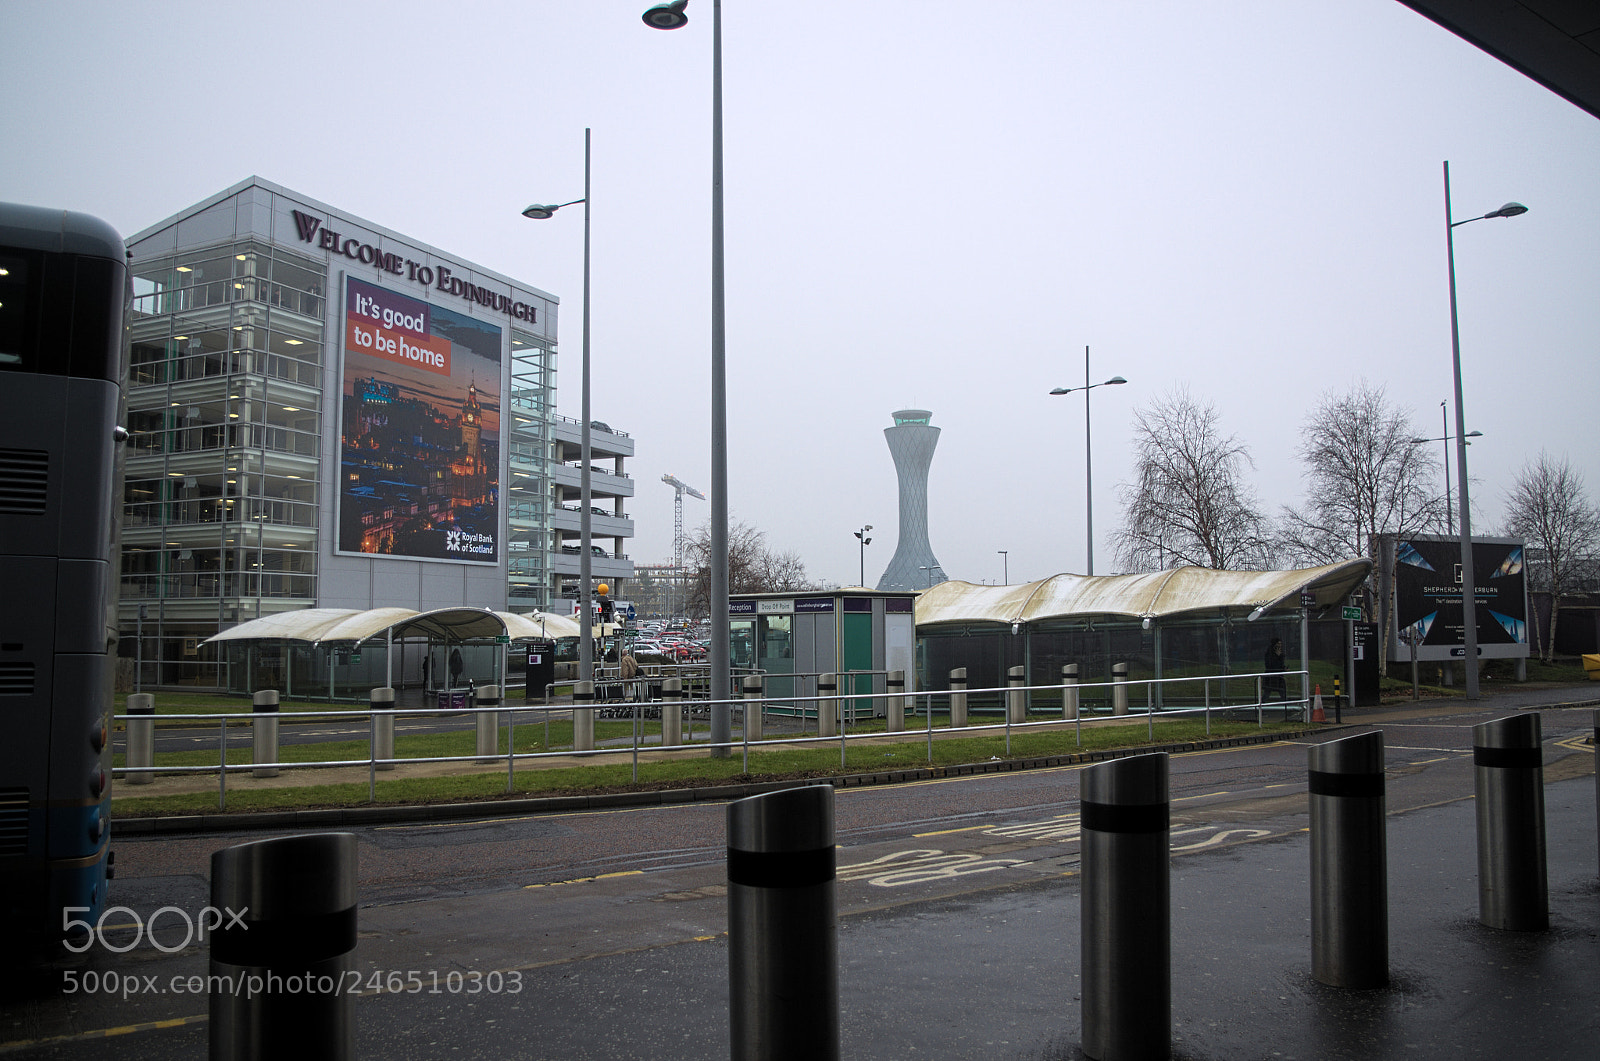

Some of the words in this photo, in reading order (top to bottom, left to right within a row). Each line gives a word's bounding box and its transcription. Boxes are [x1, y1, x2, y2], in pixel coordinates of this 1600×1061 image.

[292, 209, 404, 276] WELCOME
[406, 259, 434, 285] TO
[436, 265, 538, 324] EDINBURGH
[356, 293, 380, 319] It's
[383, 308, 424, 333] good
[354, 326, 372, 347] to
[375, 329, 396, 354] be
[399, 336, 444, 367] home
[461, 531, 478, 543] Royal
[478, 533, 493, 543] Bank
[461, 543, 469, 552] of
[469, 543, 493, 554] Scotland
